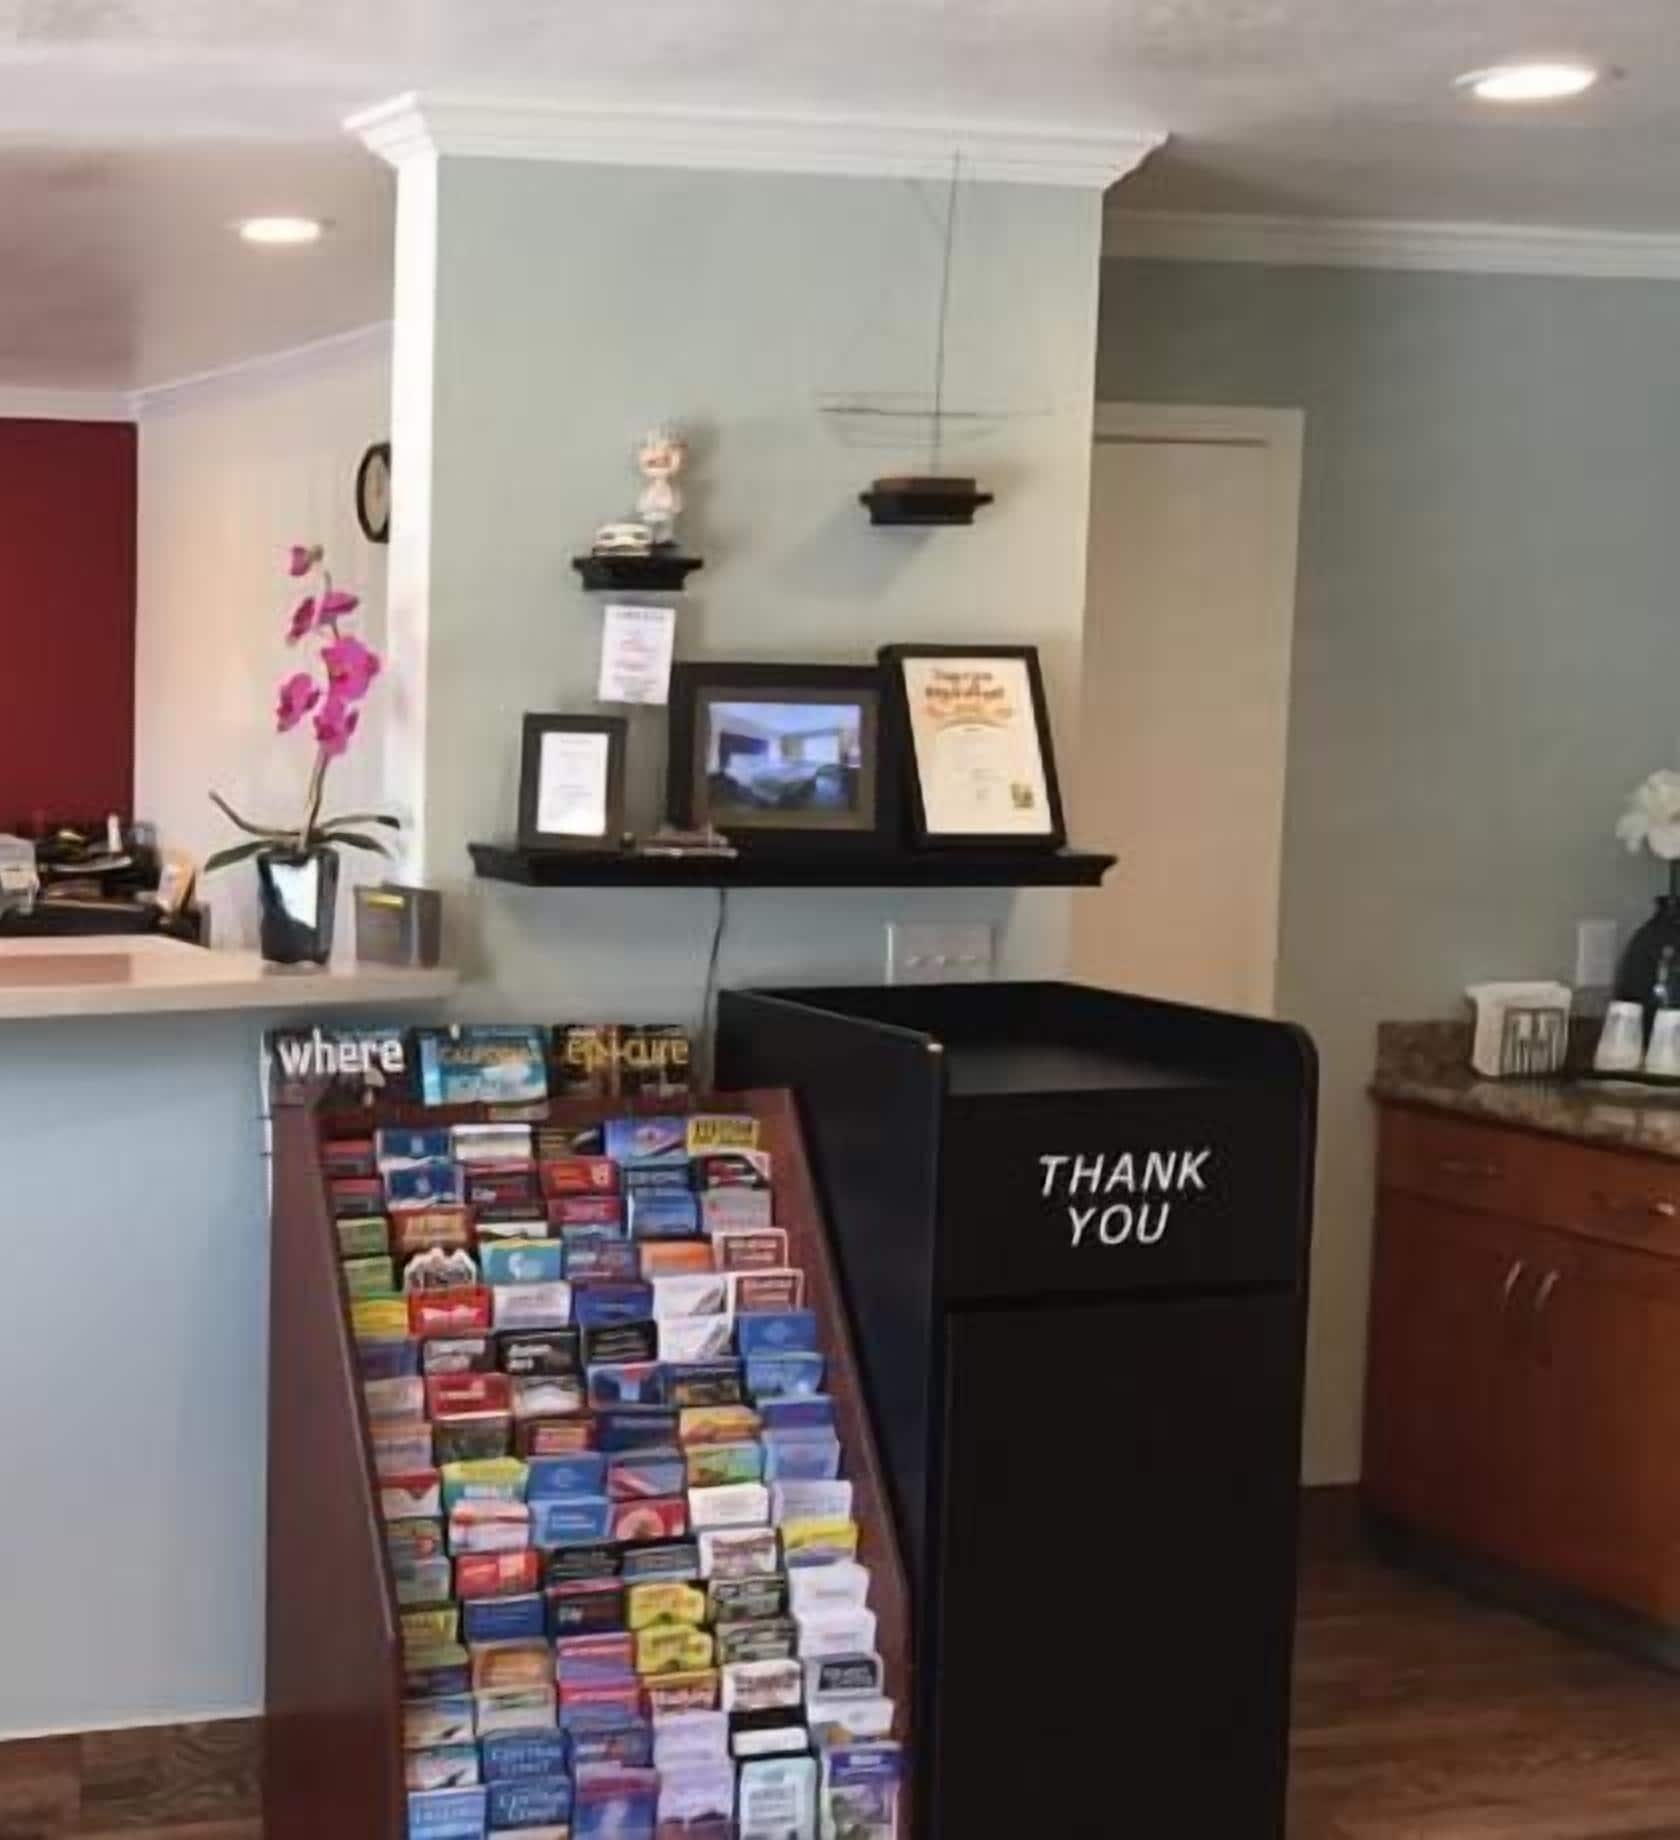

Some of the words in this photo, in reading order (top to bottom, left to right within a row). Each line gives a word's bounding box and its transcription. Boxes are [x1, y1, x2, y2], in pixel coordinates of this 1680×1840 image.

[277, 1027, 406, 1074] where
[1038, 1147, 1211, 1197] THANK
[1068, 1202, 1170, 1247] YOU
